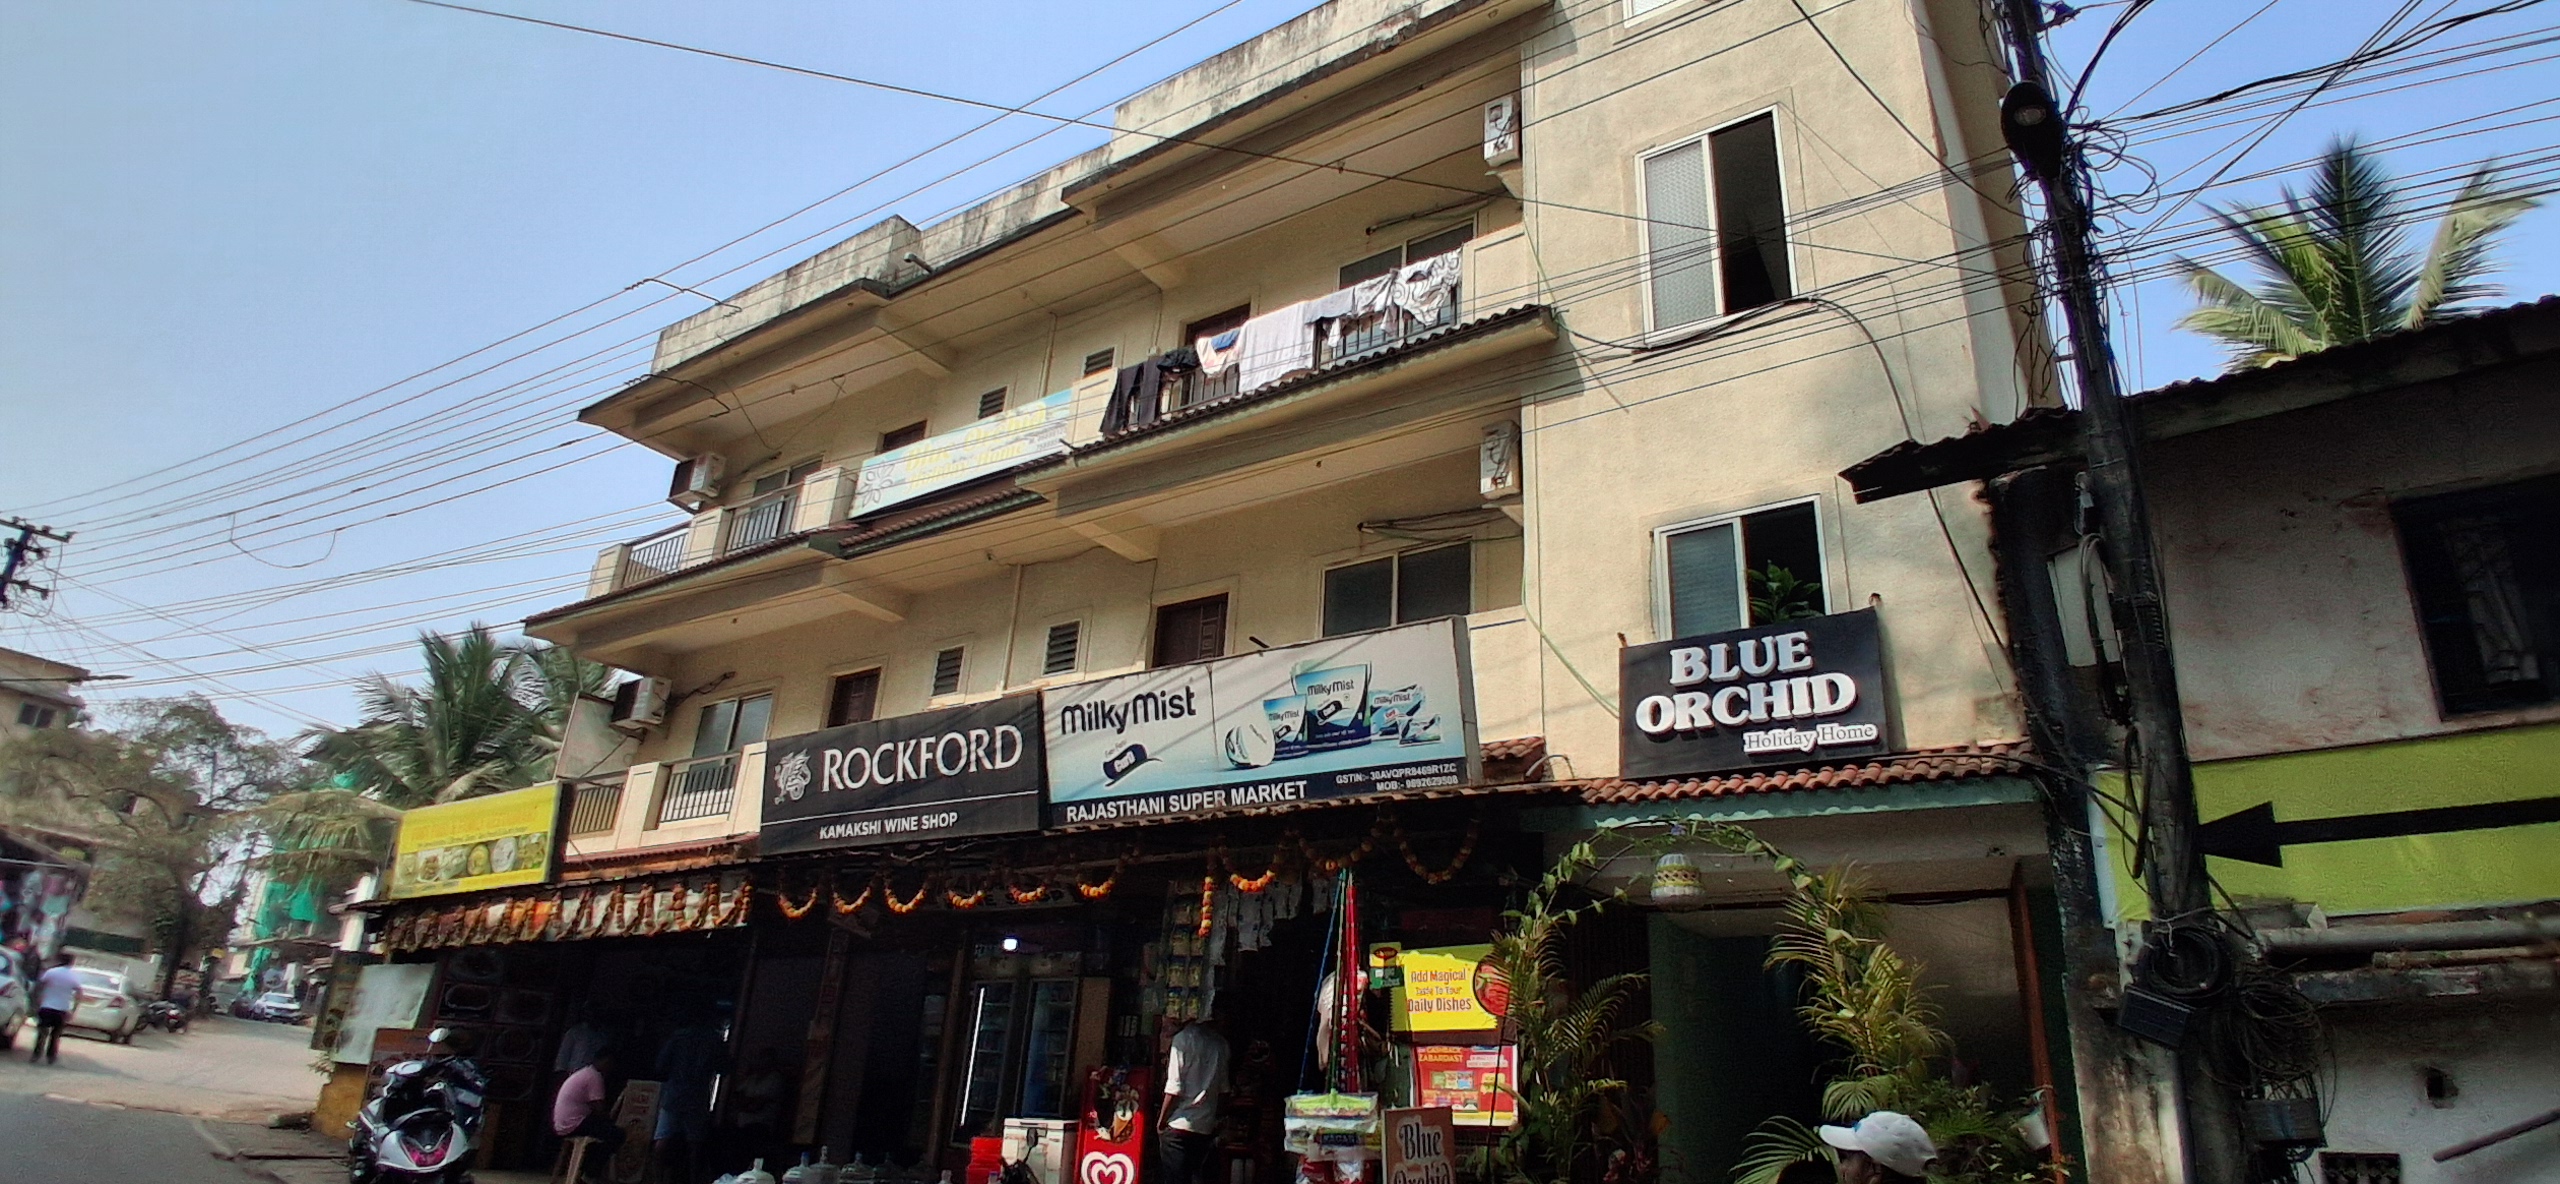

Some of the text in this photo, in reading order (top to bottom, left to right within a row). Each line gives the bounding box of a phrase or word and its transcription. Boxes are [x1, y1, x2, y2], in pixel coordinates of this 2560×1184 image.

[1669, 631, 1814, 687] BLUE
[1635, 672, 1858, 735] ORCHID
[1746, 724, 1875, 751] Holiday Home
[821, 724, 1023, 792] ROCKFORD
[1066, 781, 1307, 823] RAJASTHANI SUPER MARKET
[819, 812, 958, 839] KAMAKSHI WINE SHOP
[1411, 971, 1428, 982] Add
[1430, 968, 1466, 984] Magical
[1407, 996, 1472, 1013] Daily Dishes
[1398, 1121, 1441, 1160] Blue
[1394, 1163, 1451, 1184] hid
